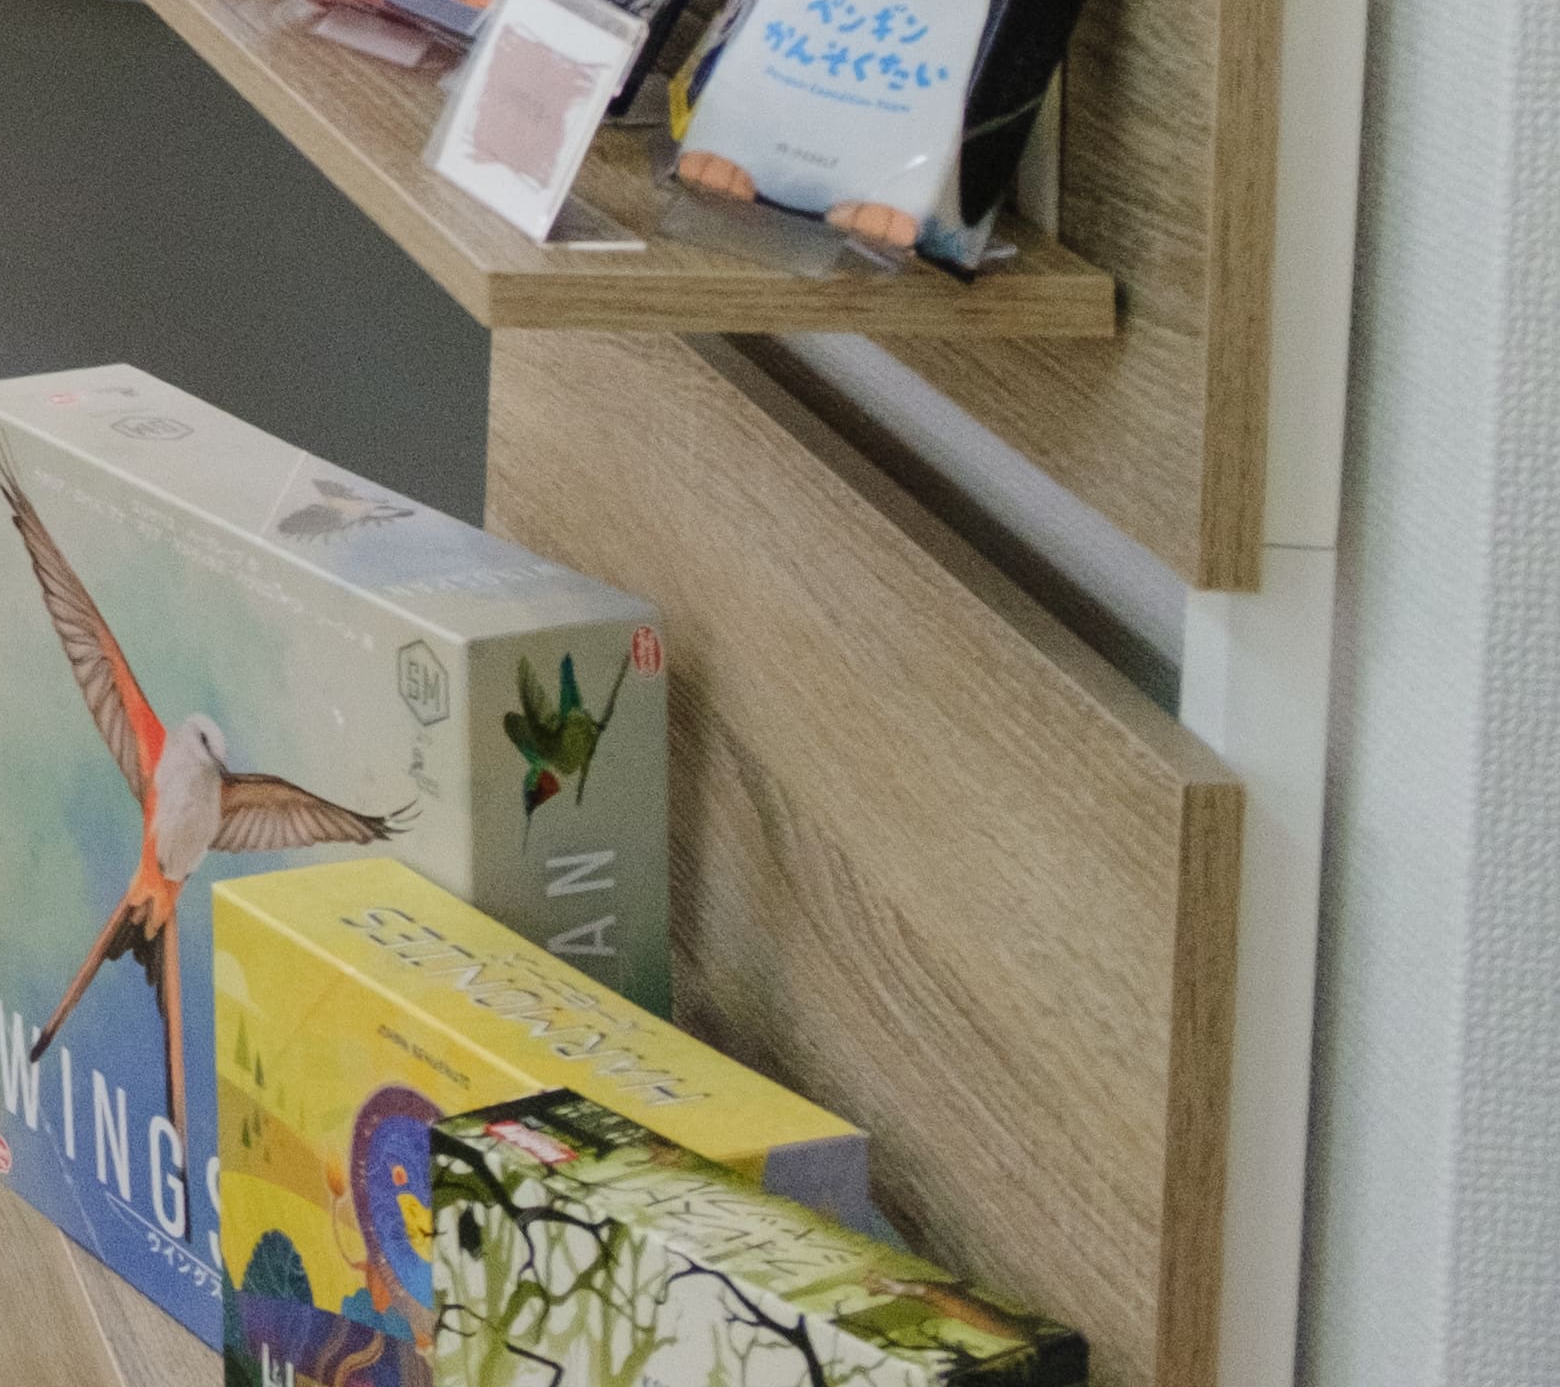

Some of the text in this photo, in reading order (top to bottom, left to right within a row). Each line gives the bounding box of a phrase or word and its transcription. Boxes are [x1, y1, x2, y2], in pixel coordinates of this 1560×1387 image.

[340, 907, 711, 1106] HARMONIES
[147, 1231, 223, 1298] ウイングス
